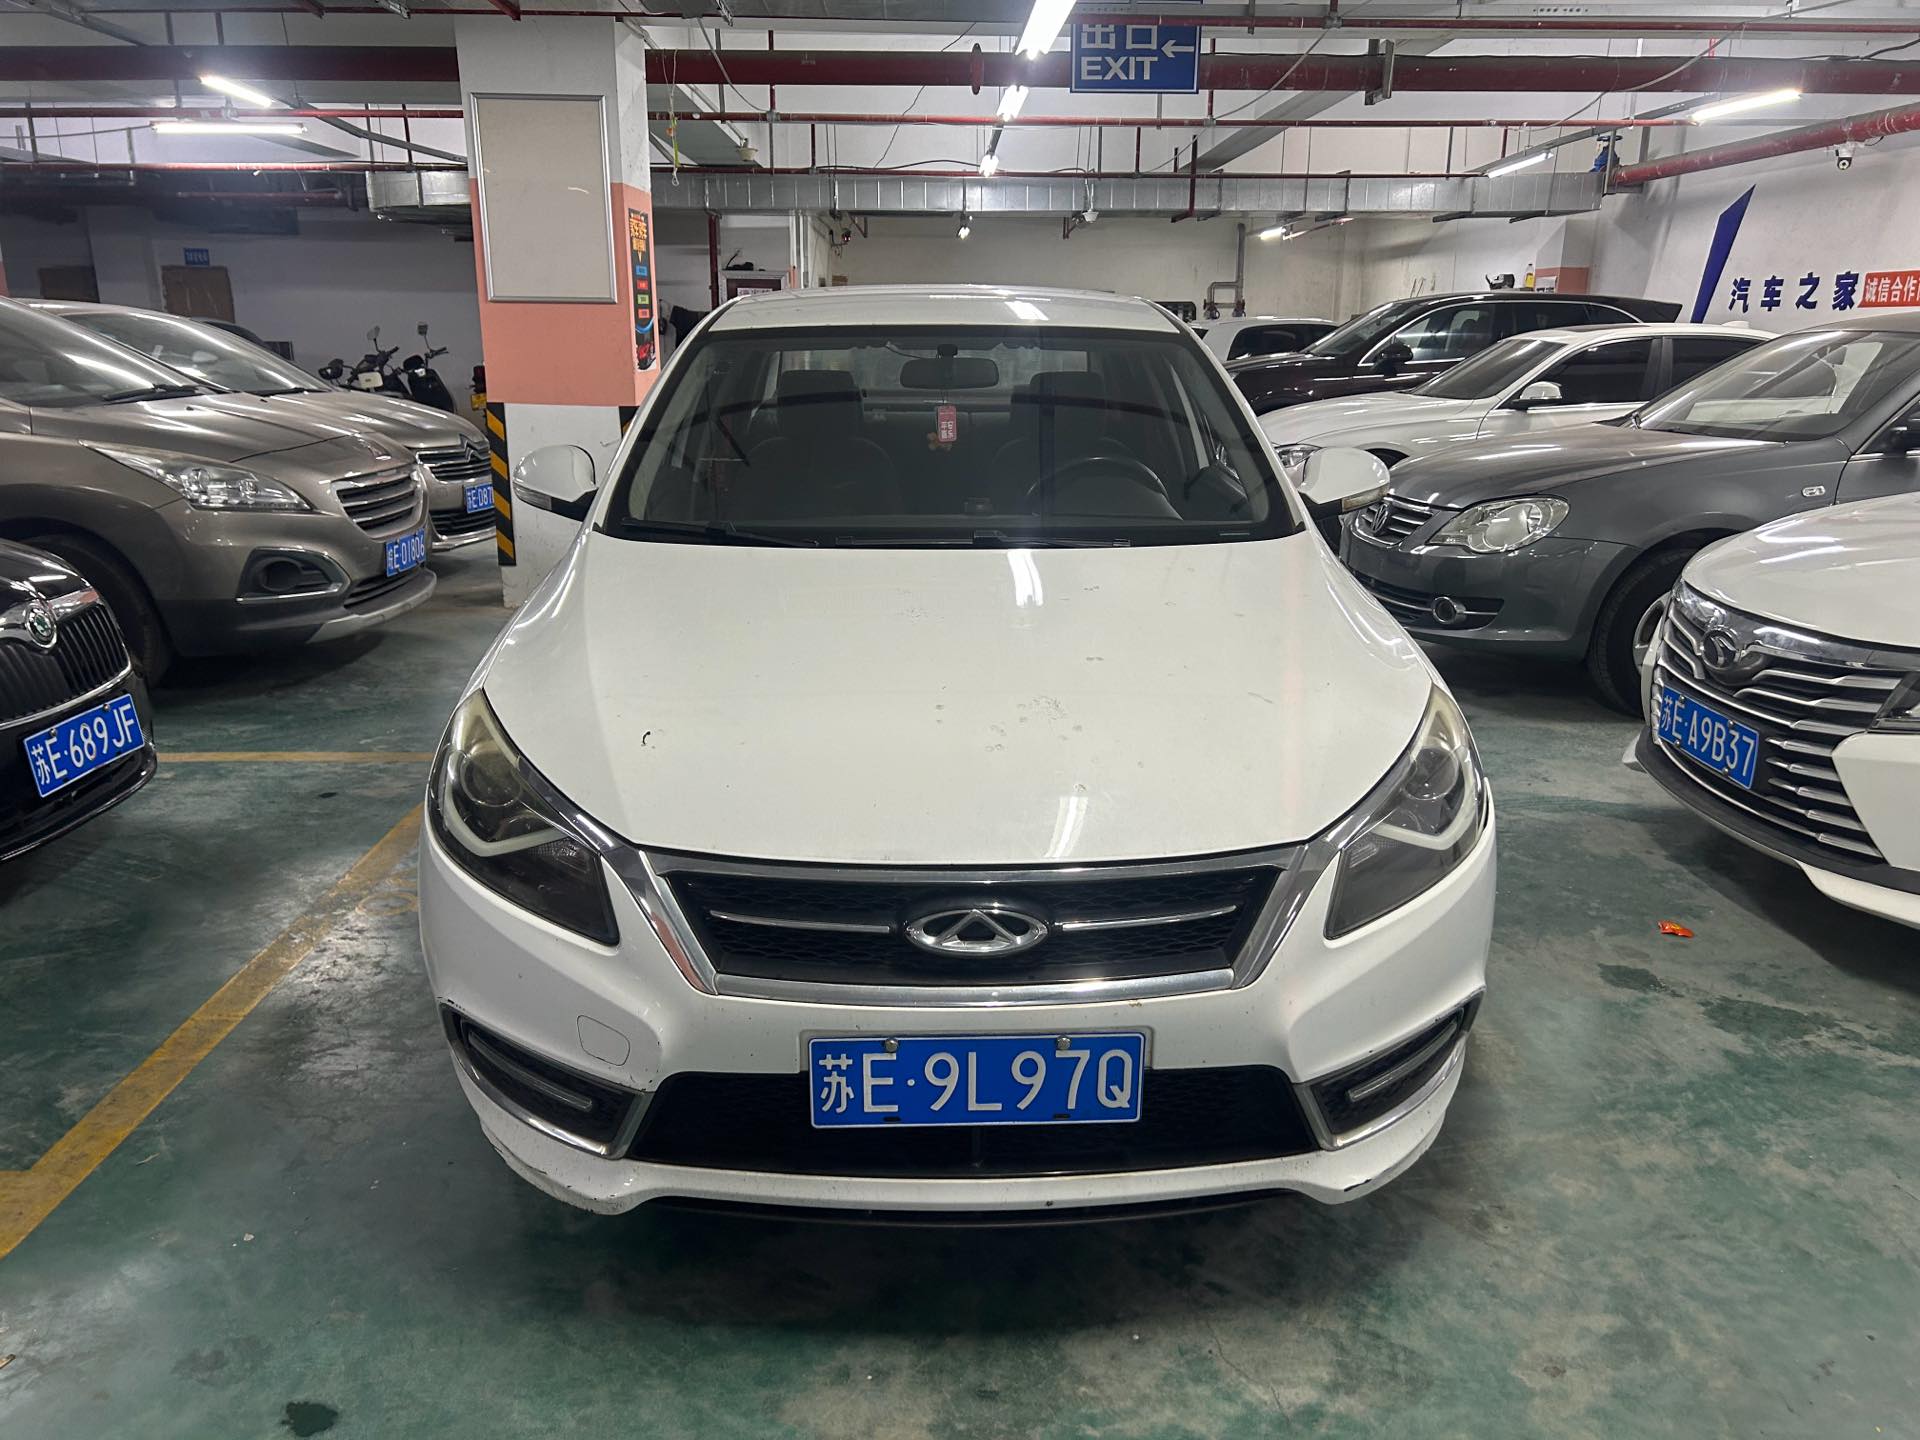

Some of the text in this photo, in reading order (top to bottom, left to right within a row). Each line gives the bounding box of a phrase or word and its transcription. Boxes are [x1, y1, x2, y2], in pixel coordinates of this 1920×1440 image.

[1081, 24, 1158, 49] 出口
[1081, 56, 1158, 80] EXIT
[1728, 271, 1859, 313] 汽车之家
[1865, 275, 1920, 303] 诚信合作
[819, 1049, 1133, 1113] 苏E·9L97Q
